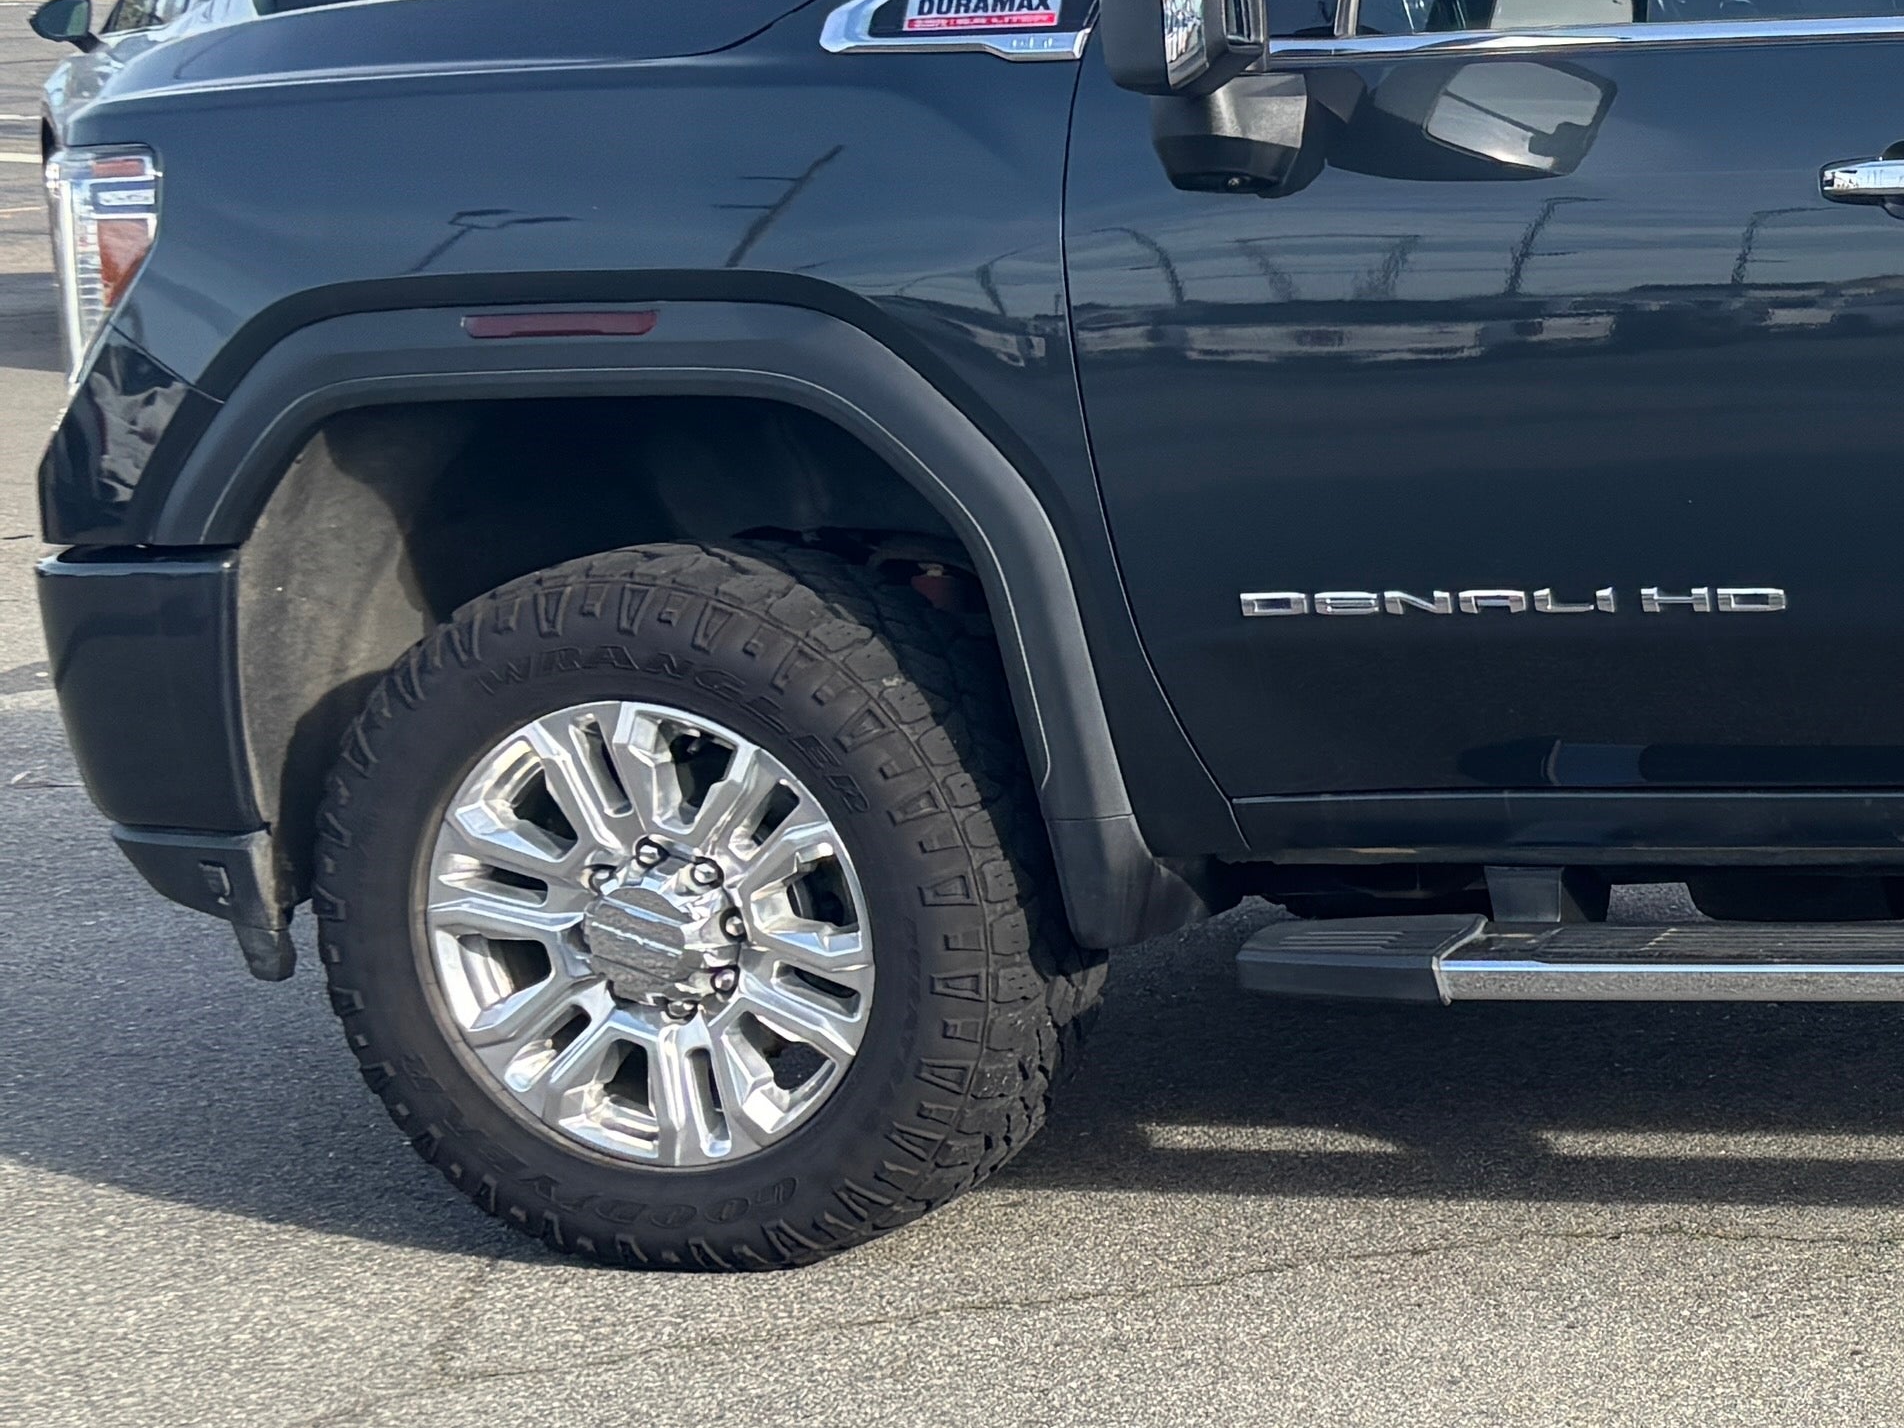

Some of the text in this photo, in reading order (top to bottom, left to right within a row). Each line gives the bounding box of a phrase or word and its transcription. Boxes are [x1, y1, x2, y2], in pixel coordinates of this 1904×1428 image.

[1240, 587, 1786, 617] DENALI HD
[477, 644, 872, 813] WRANGLER
